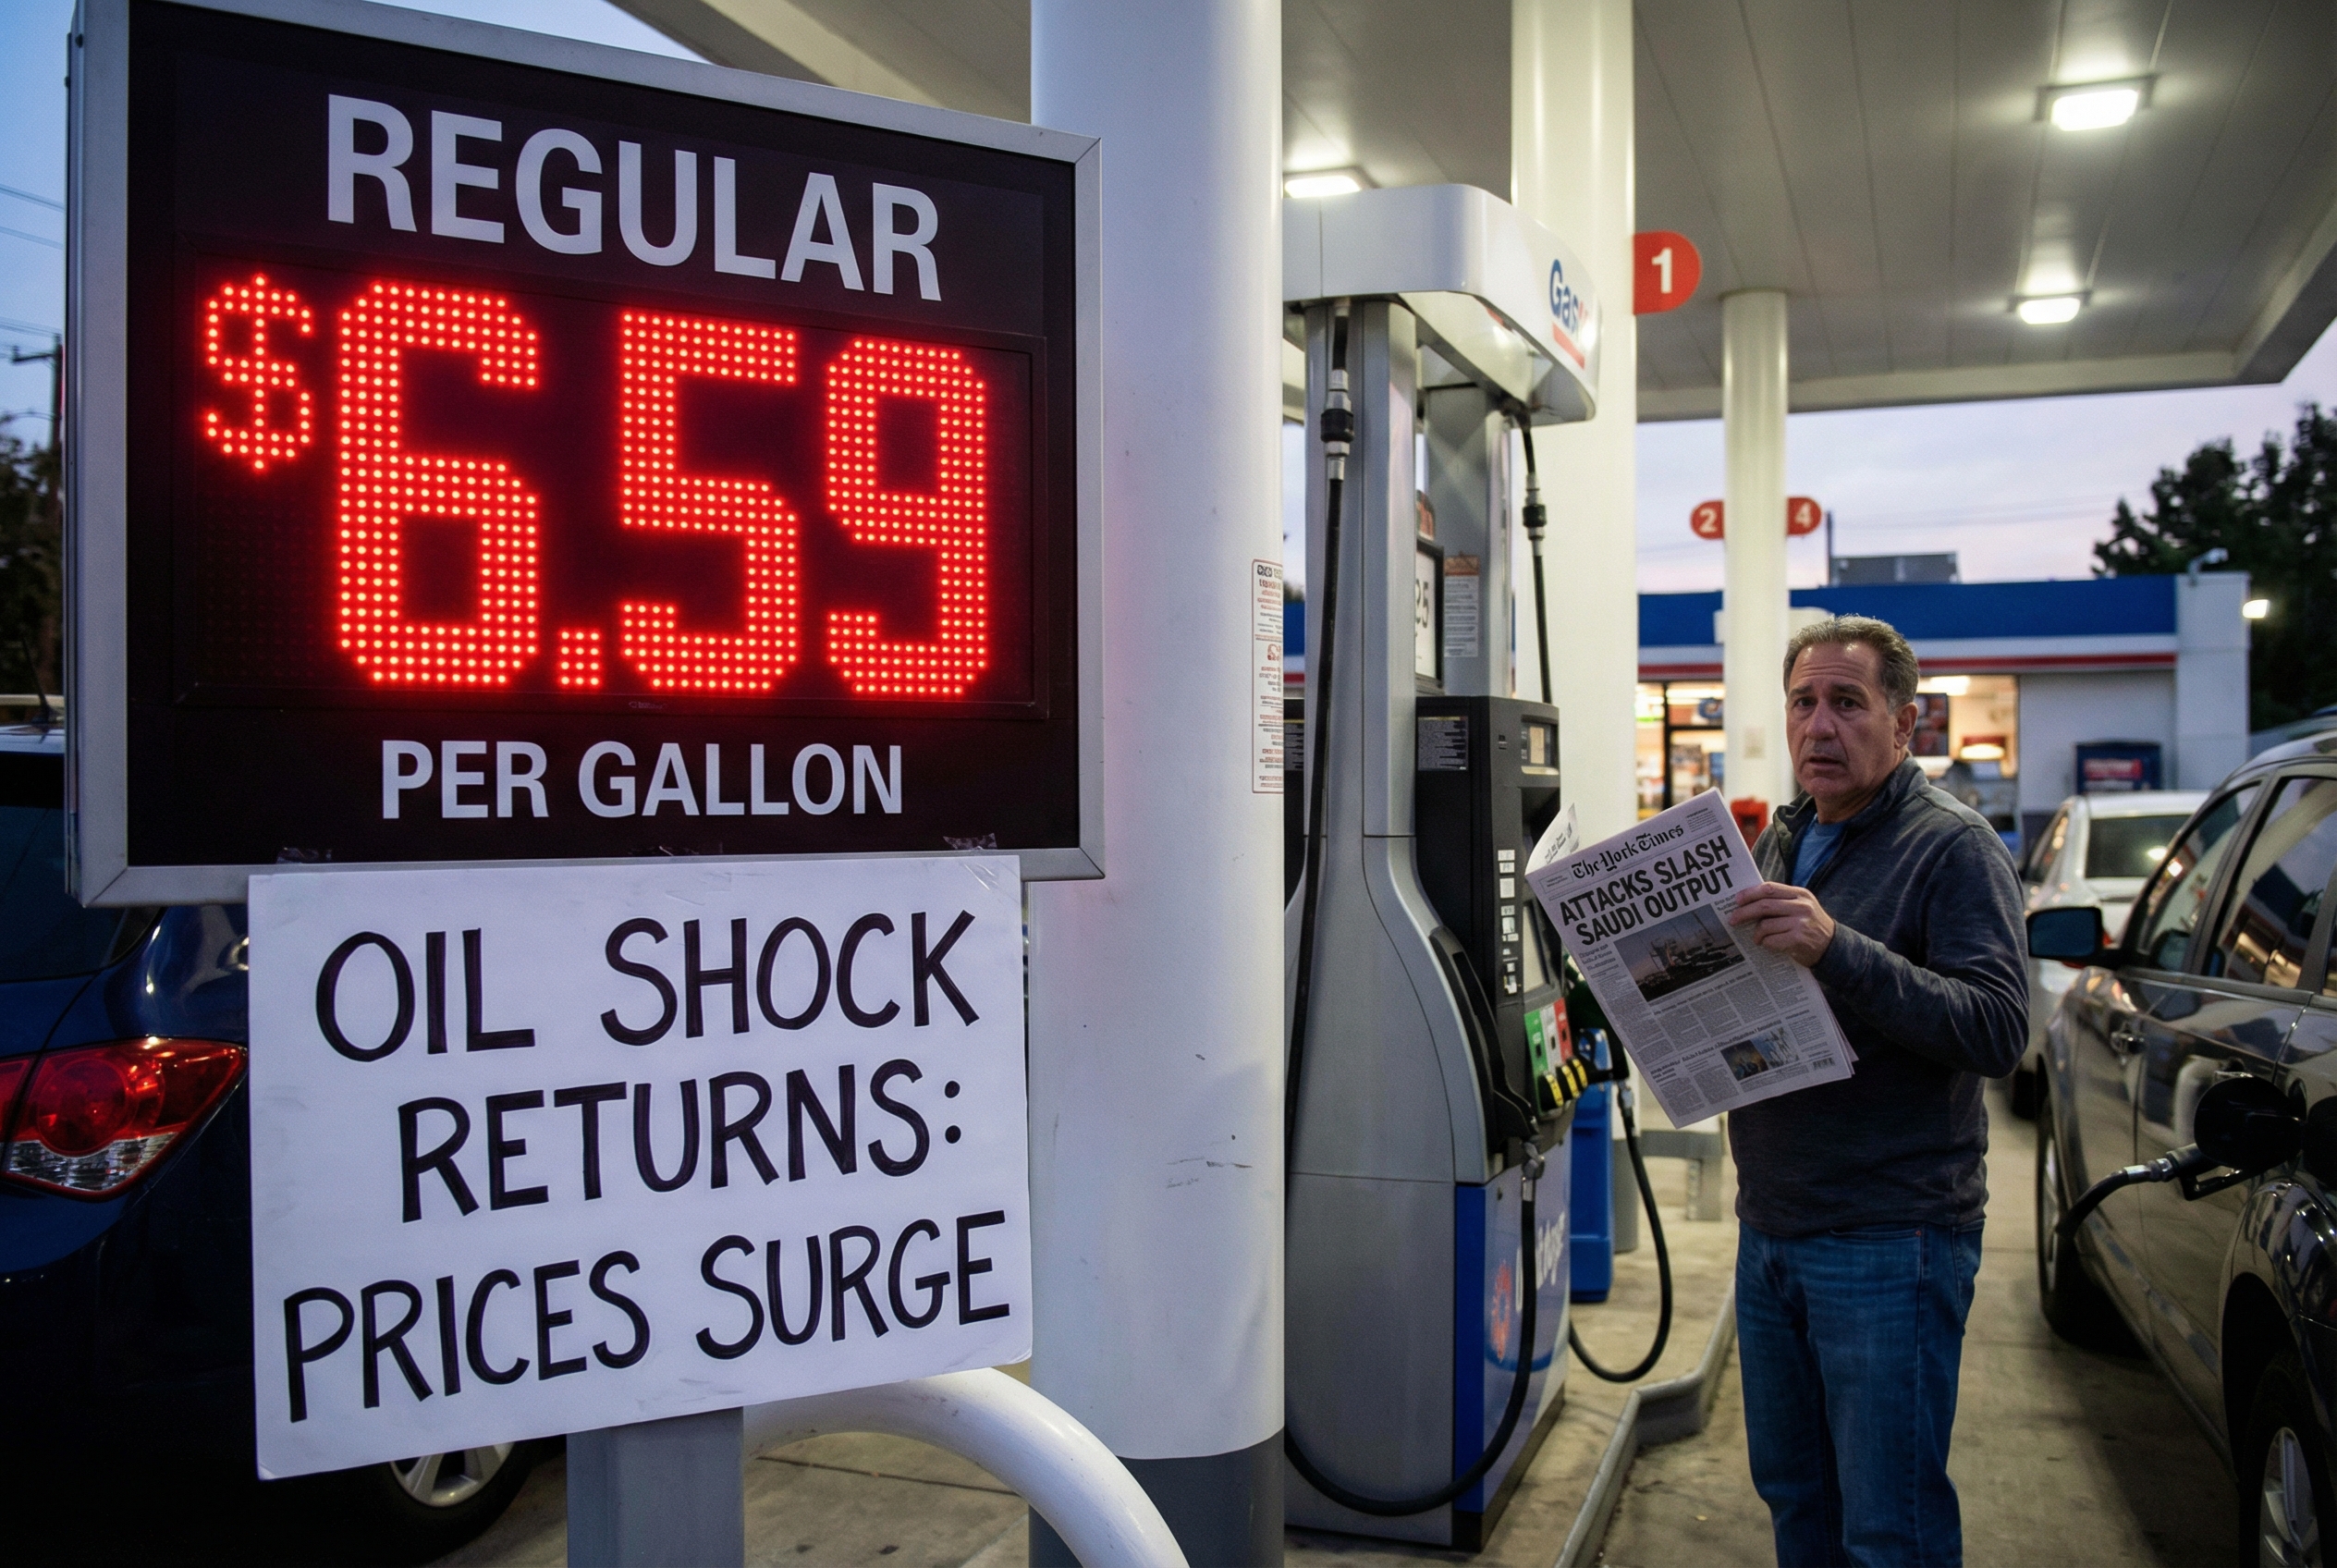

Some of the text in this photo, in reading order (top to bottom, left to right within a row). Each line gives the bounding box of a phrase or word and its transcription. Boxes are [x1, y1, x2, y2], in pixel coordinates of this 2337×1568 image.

[329, 93, 942, 301] REGULAR
[1651, 247, 1672, 294] 1
[202, 272, 991, 699] $6.59
[1698, 508, 1719, 534] 2
[1794, 502, 1814, 530] 4
[382, 740, 902, 819] PER GALLON
[1560, 869, 1654, 927] ATTACKS
[1653, 835, 1732, 885] SLASH
[1572, 860, 1600, 879] The
[1635, 825, 1684, 851] Times
[1576, 902, 1645, 947] SAUDI
[1644, 863, 1734, 919] OUTPUT
[316, 911, 980, 1062] OIL SHOCK
[398, 1059, 961, 1223] RETURNS:
[283, 1209, 1010, 1424] PRICES SURGE
